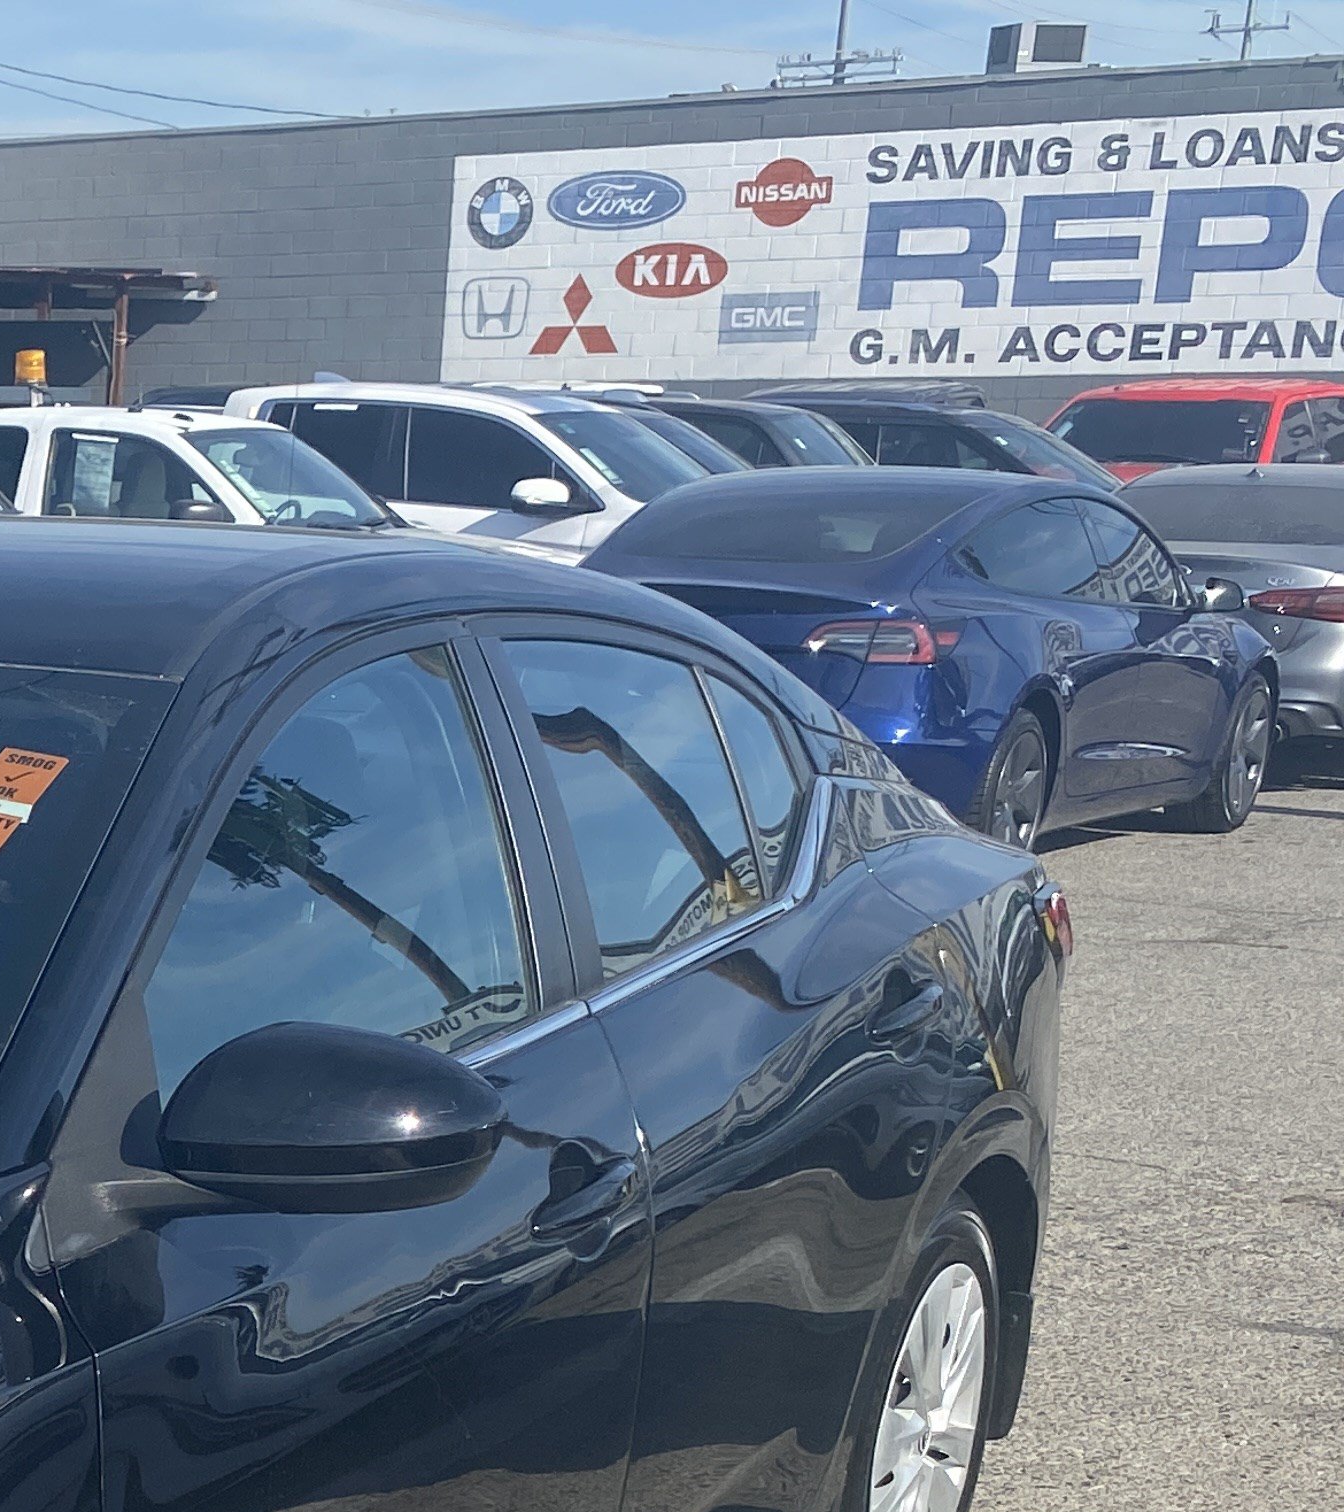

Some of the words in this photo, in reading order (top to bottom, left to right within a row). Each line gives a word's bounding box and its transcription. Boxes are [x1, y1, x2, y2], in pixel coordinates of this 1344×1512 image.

[865, 136, 1073, 184] SAVING
[1097, 133, 1130, 171] &
[1149, 122, 1344, 171] LOANS
[576, 183, 656, 216] Ford
[740, 181, 828, 204] NISSAN
[857, 185, 1344, 312] REP
[632, 254, 712, 287] KIA
[730, 306, 806, 329] GMC
[849, 327, 976, 365] G.M.
[998, 319, 1344, 363] ACCEPTAN
[4, 752, 58, 771] SMOG
